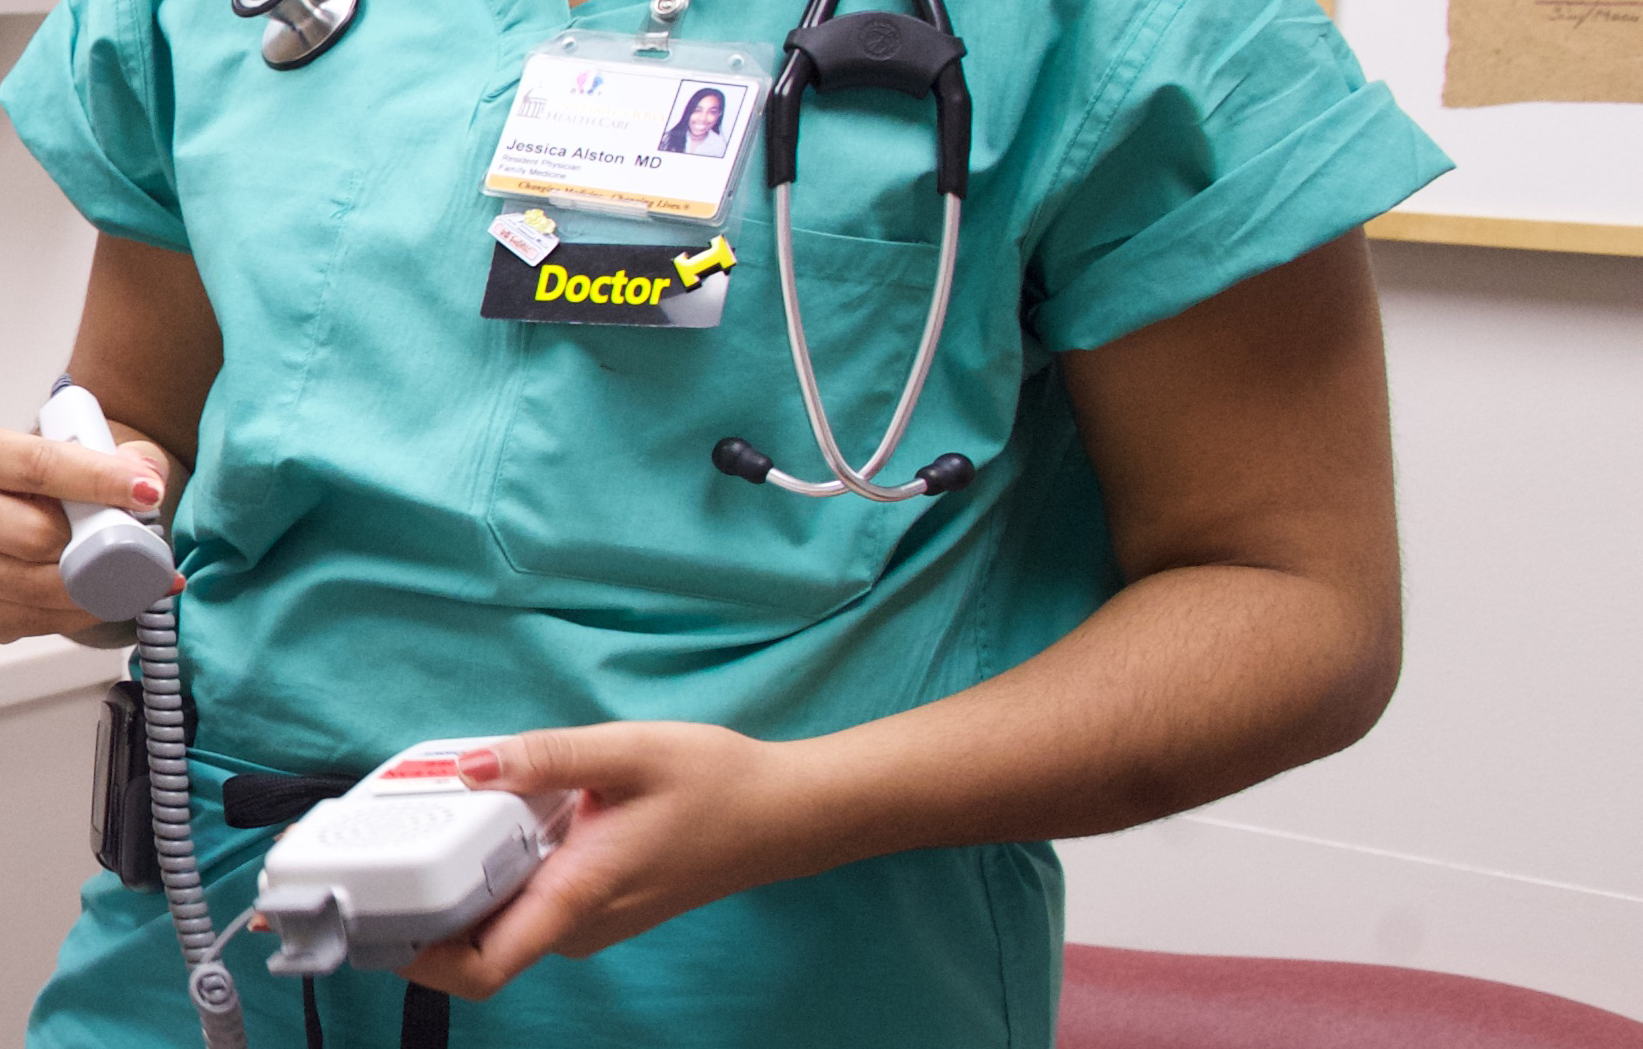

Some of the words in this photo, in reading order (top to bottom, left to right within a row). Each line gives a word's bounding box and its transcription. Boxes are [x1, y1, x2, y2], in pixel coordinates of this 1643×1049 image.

[506, 139, 566, 157] Jessica
[572, 147, 624, 165] Alston
[634, 154, 662, 169] MD
[535, 264, 671, 305] Doctor
